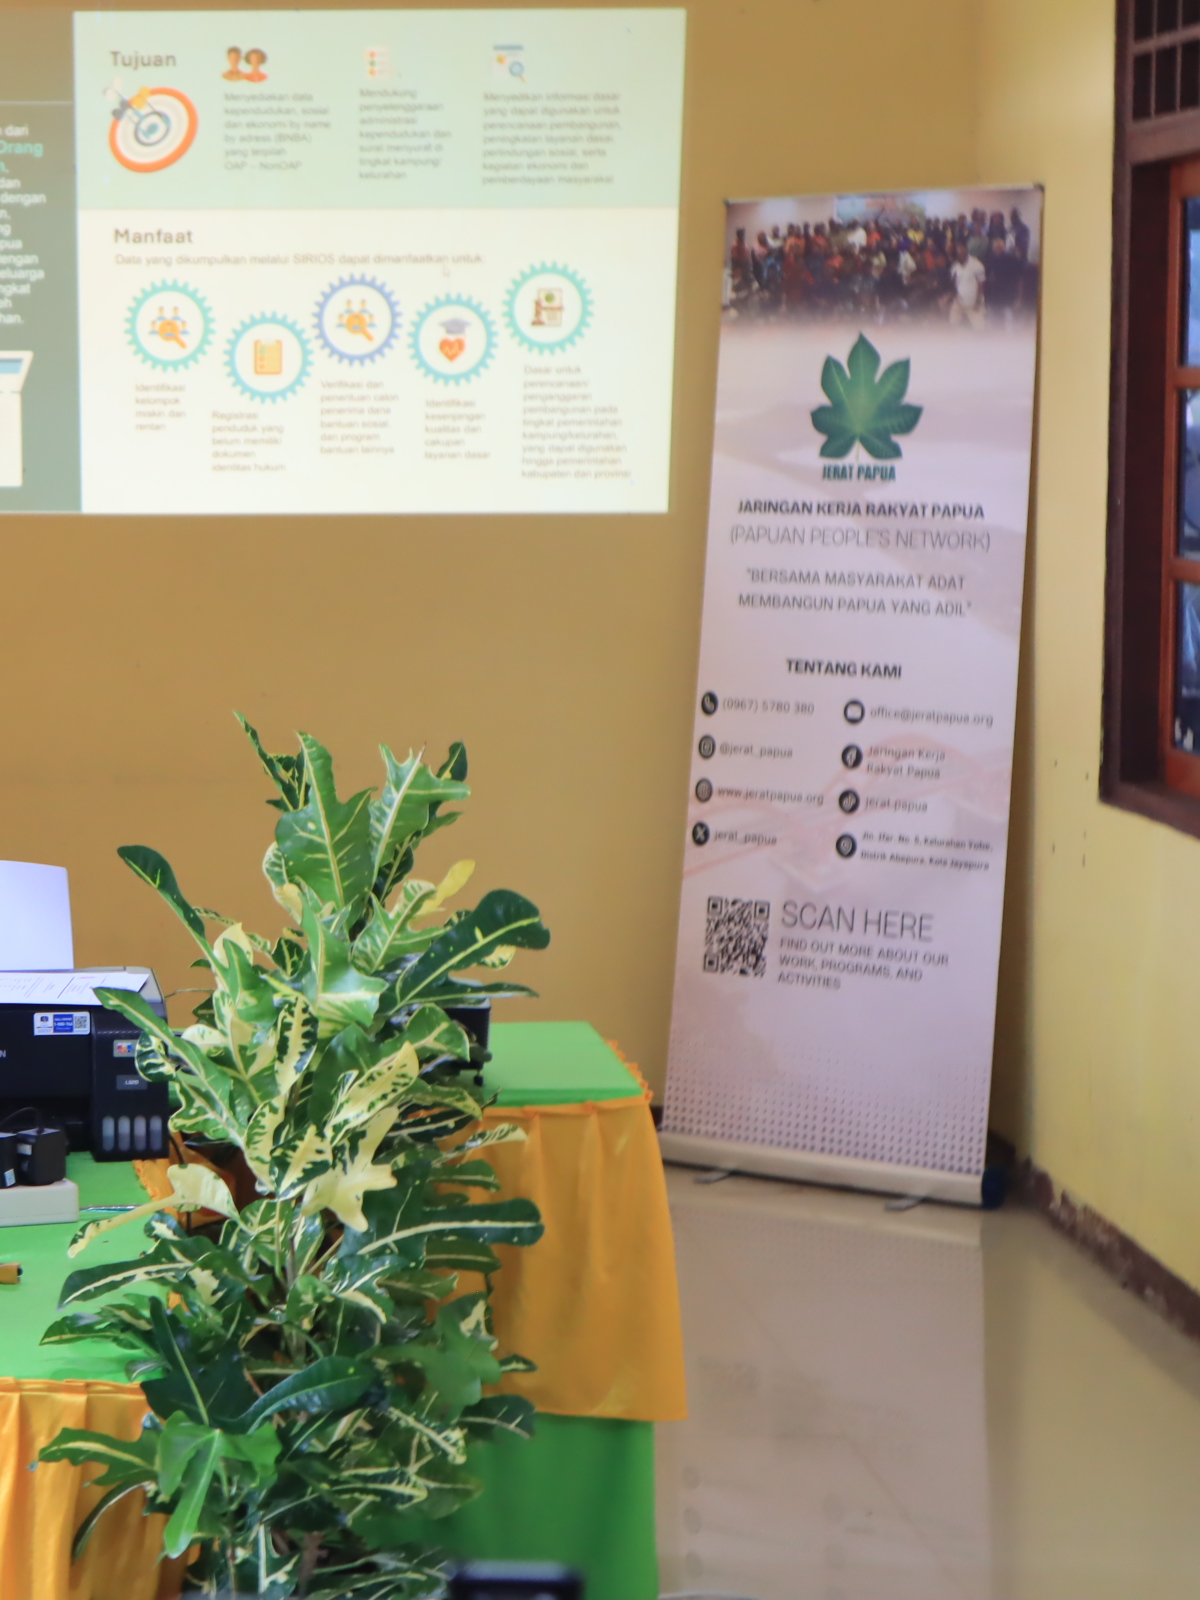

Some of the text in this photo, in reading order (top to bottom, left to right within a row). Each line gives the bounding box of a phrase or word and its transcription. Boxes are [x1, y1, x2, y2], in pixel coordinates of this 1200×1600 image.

[110, 51, 176, 71] Tujuan
[113, 228, 192, 244] Manfaat
[293, 253, 335, 265] SIRIOS
[822, 464, 896, 482] JERAT PAPUA
[738, 500, 985, 519] JARINGAN KERJA RAKYAT PAPUA
[731, 524, 805, 545] (PAPUAN
[895, 529, 991, 552] NETWORK)
[825, 571, 923, 589] MASYARAKAT
[928, 574, 965, 590] ADAT
[738, 593, 833, 611] MEMBANGUN
[837, 597, 886, 614] PAPUA
[891, 598, 931, 616] YANG
[786, 658, 902, 679] TENTANG KAMI
[781, 900, 934, 942] SCAN HERE
[780, 937, 949, 966] FIND OUT MORE ABOUT OUR
[778, 971, 841, 990] ACTIVITIES
[896, 967, 923, 982] AND
